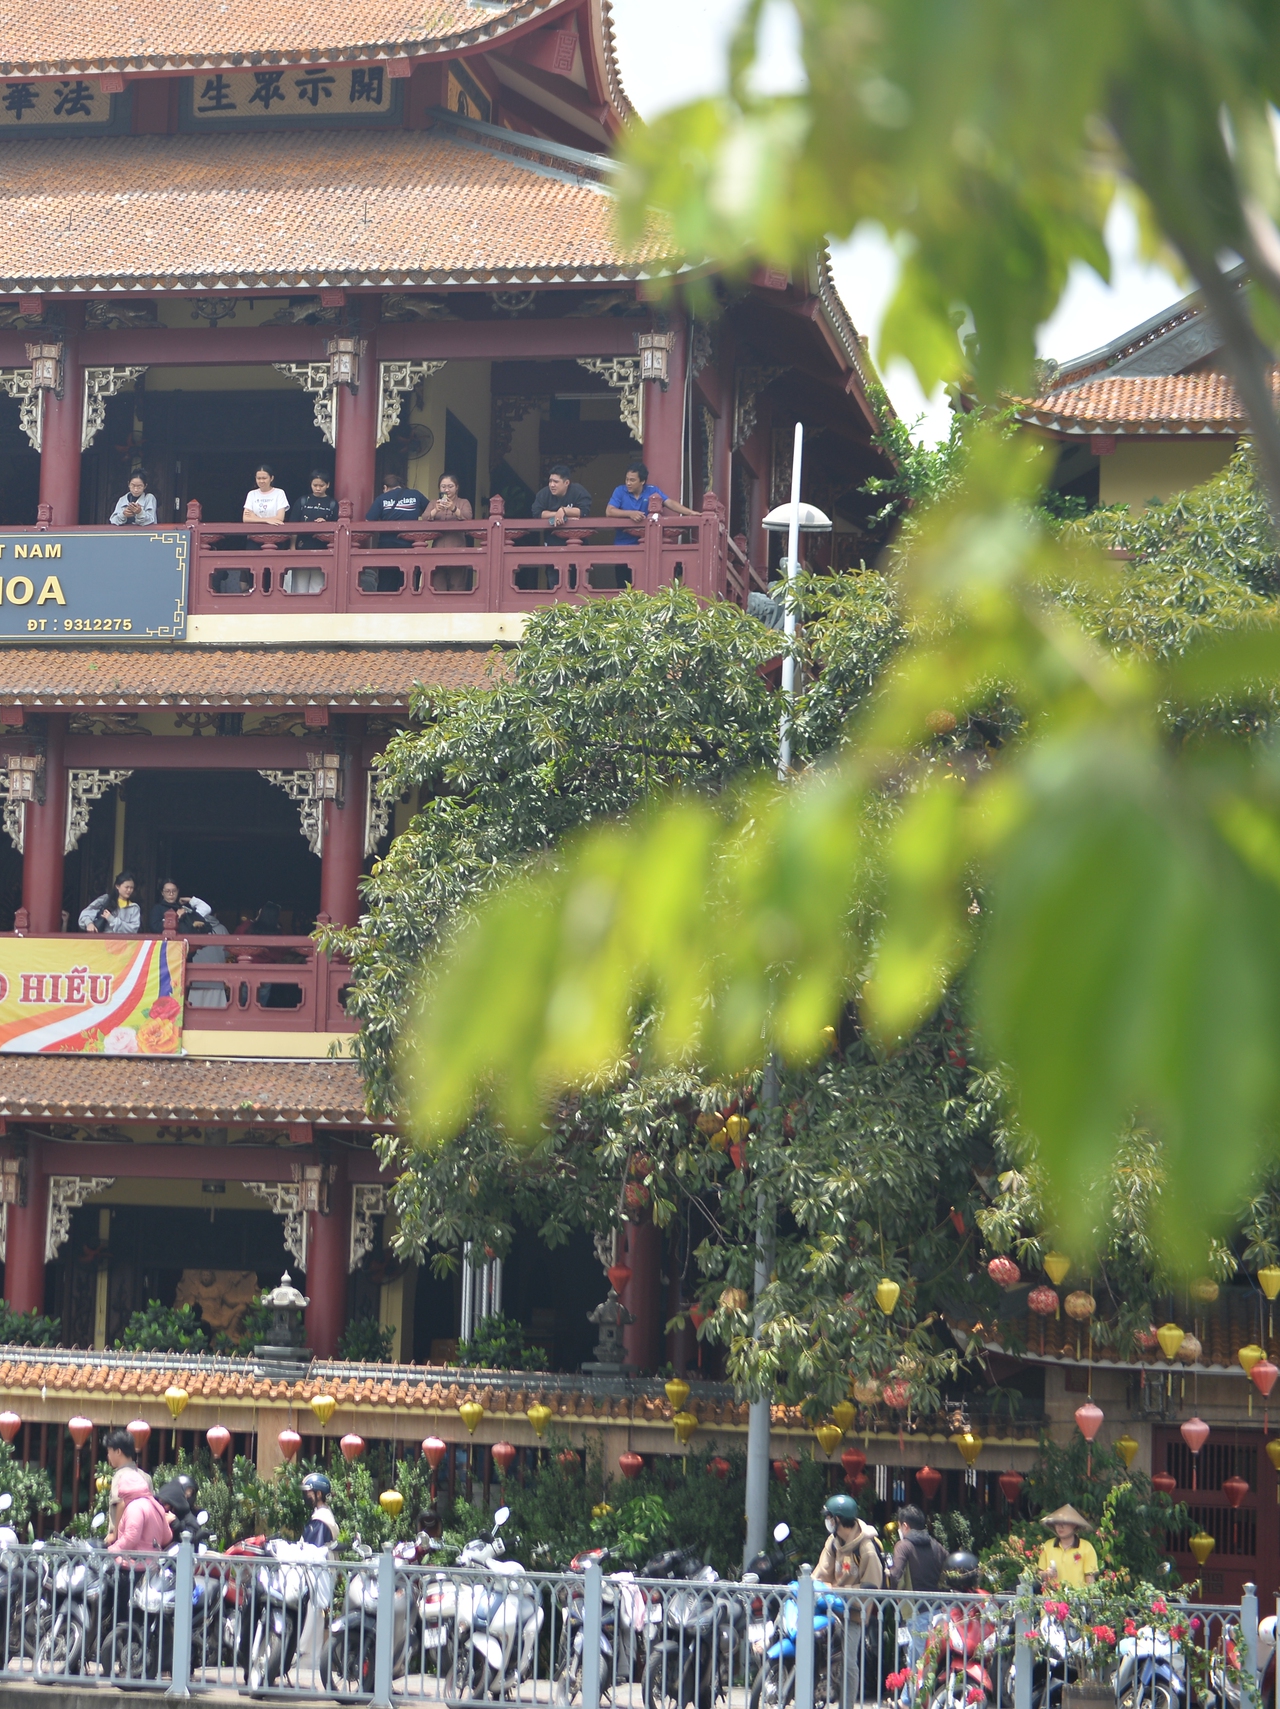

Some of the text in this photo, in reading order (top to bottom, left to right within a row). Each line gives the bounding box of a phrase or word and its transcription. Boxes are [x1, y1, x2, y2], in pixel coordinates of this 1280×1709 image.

[14, 543, 62, 559] NAM
[27, 619, 48, 631] ĐT
[64, 618, 132, 631] 9312275
[19, 966, 113, 1004] HIẾU
